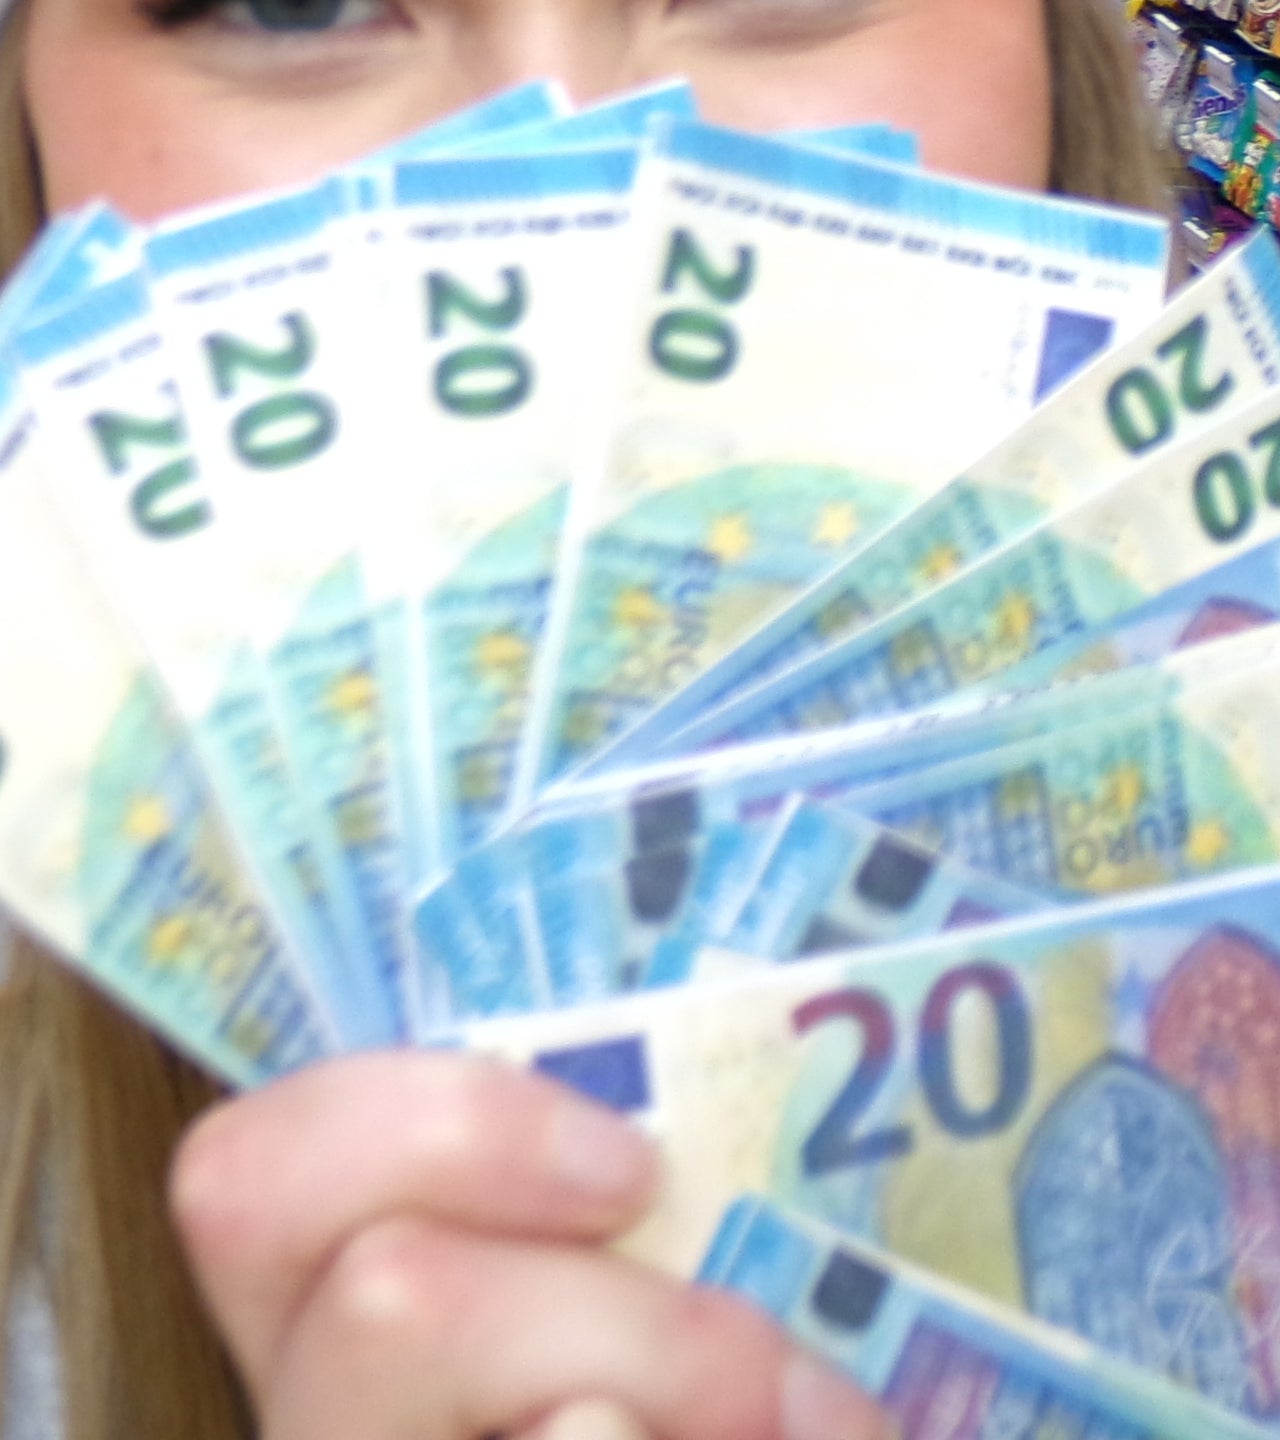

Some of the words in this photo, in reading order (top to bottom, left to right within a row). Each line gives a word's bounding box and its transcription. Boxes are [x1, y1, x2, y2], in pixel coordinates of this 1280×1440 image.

[422, 263, 535, 420] 20
[647, 225, 758, 386] 20
[1104, 313, 1236, 456] 20
[203, 309, 341, 475] 20
[788, 958, 1036, 1181] 20
